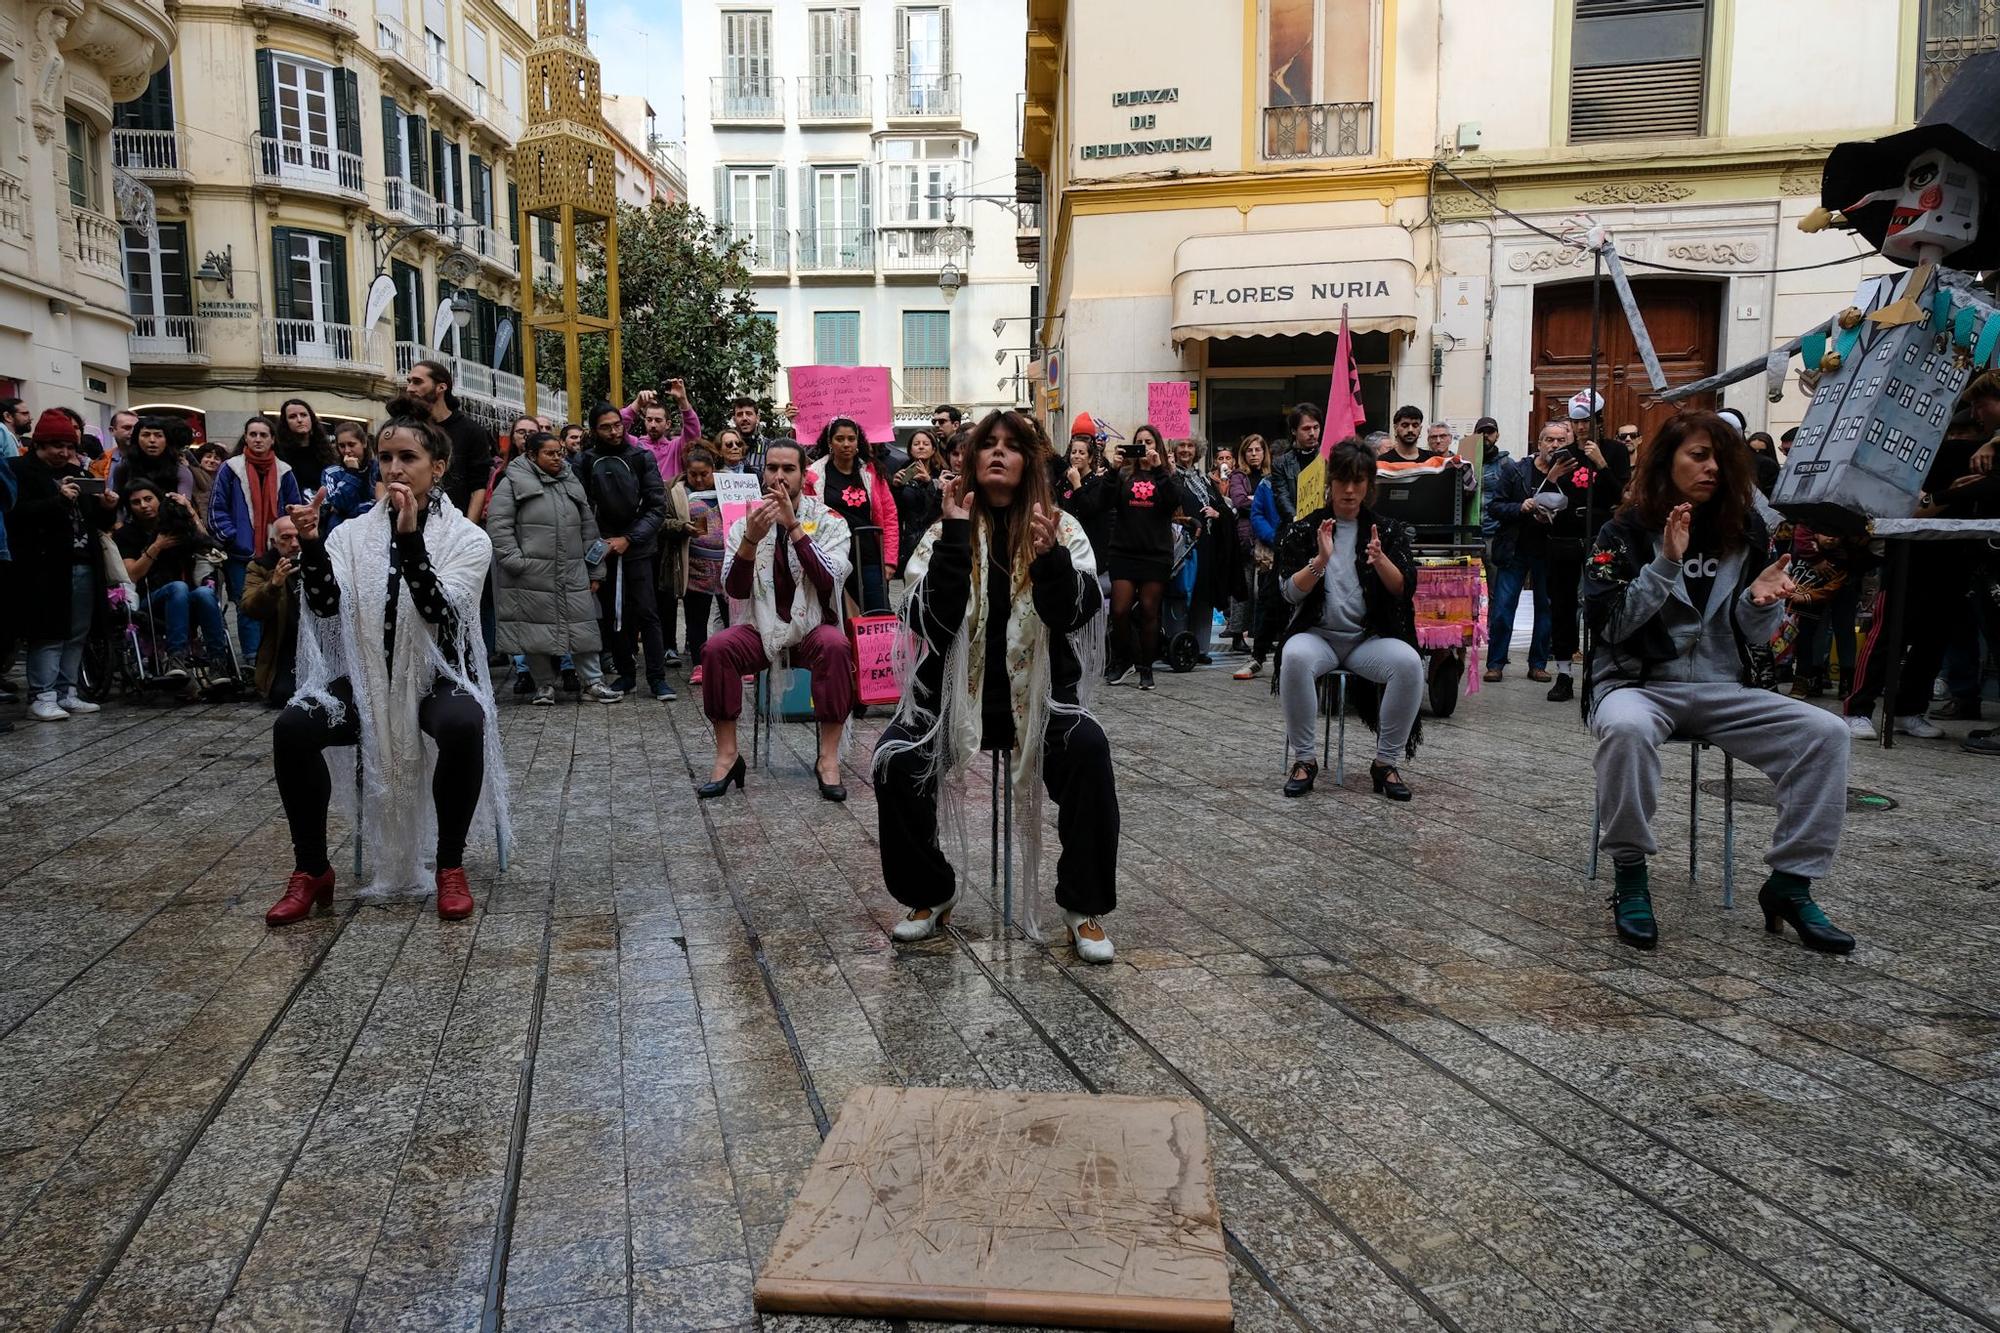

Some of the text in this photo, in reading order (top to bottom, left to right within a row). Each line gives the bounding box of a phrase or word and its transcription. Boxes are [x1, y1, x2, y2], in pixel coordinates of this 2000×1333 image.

[1112, 88, 1178, 107] PLAZA
[1130, 114, 1156, 130] DE
[1081, 136, 1212, 160] FELIX SAENZ
[1193, 281, 1390, 305] FLORES NURIA
